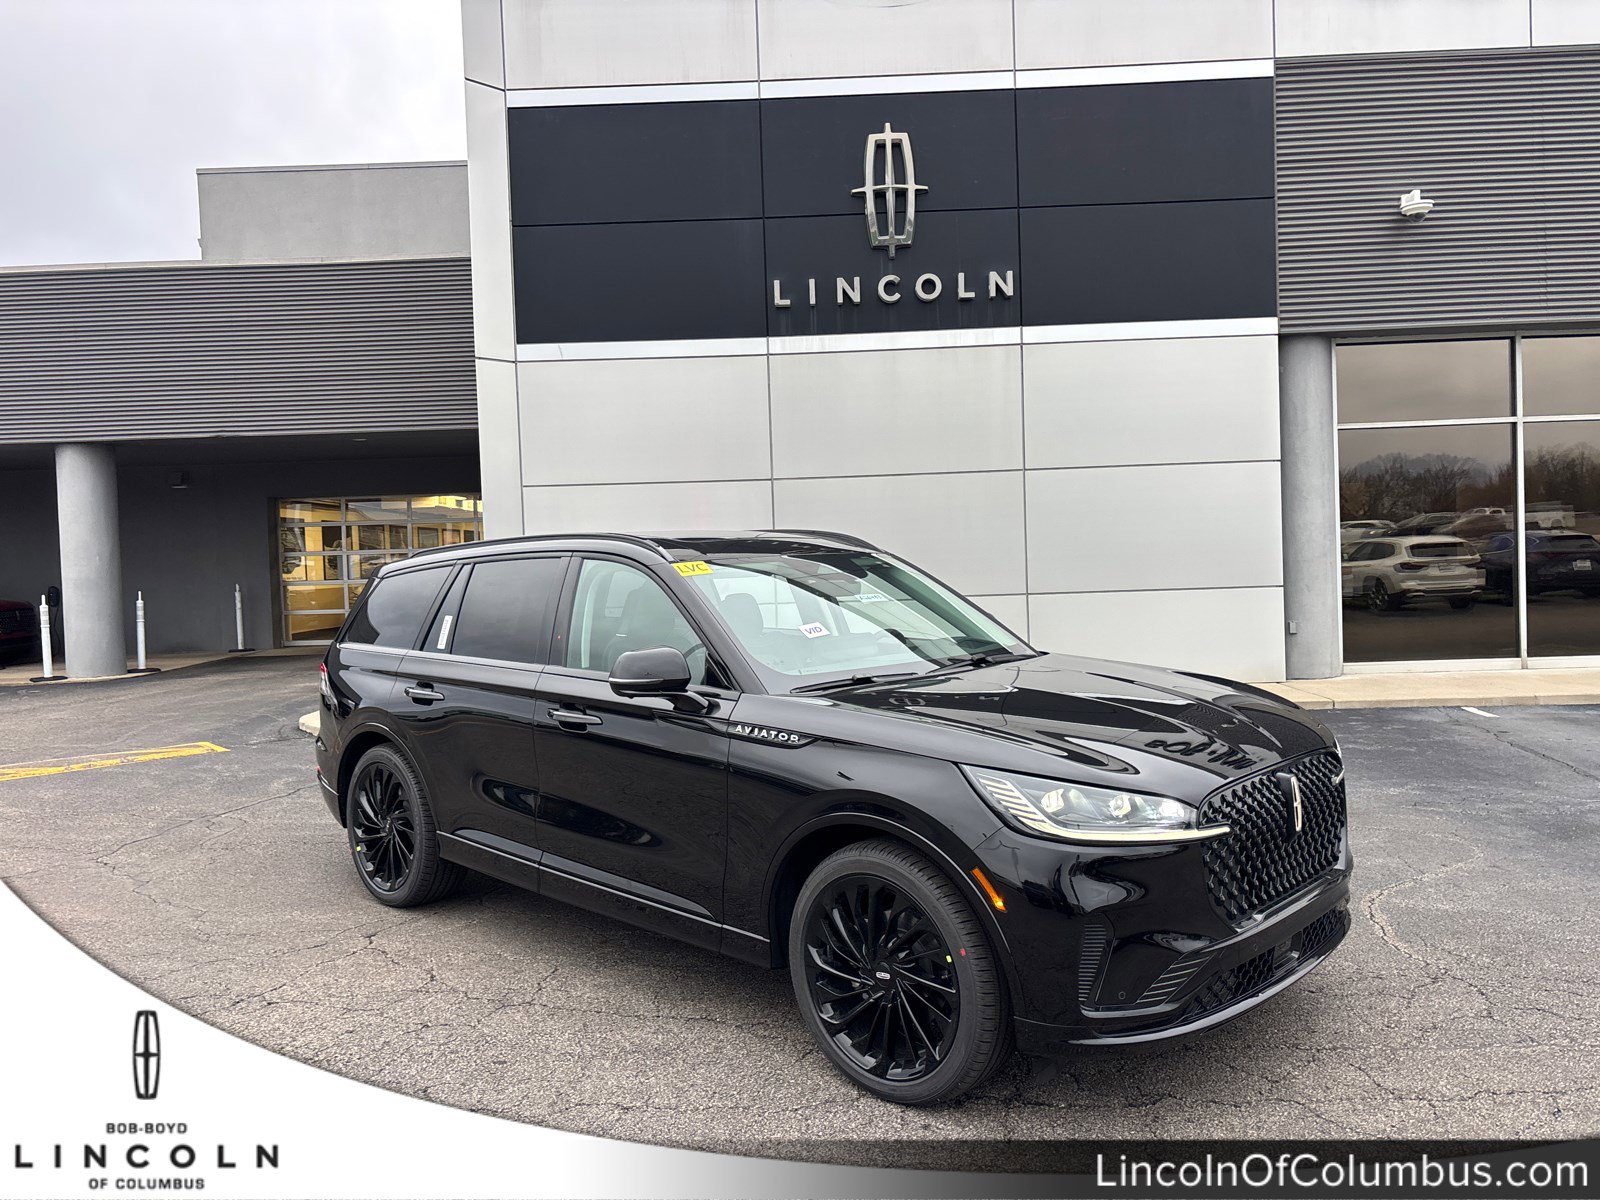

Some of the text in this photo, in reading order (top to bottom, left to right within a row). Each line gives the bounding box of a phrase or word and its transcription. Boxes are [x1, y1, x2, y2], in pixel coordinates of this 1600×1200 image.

[773, 270, 1014, 307] LINCOLN
[676, 562, 709, 574] LVC
[804, 626, 823, 635] VID
[735, 724, 799, 743] AVIATOR
